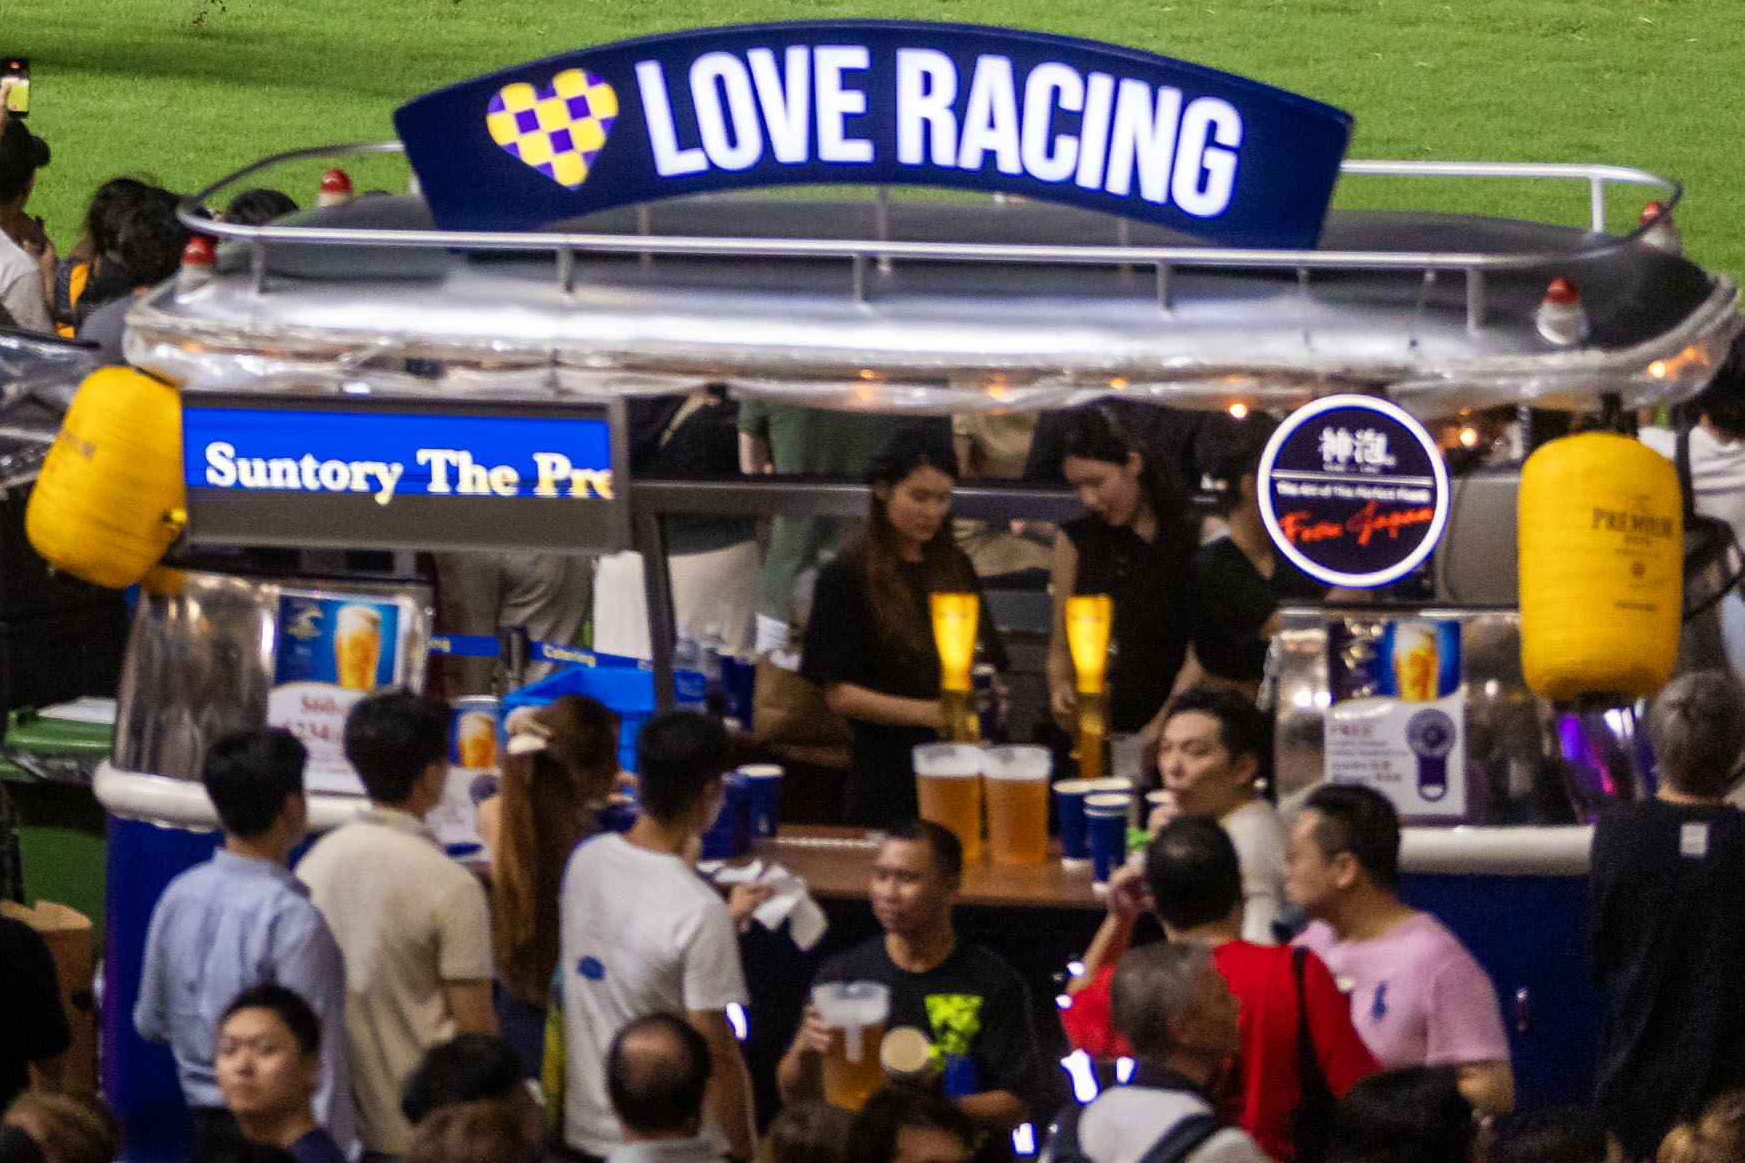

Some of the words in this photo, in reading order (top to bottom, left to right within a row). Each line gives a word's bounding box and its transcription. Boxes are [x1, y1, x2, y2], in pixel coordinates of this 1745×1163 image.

[635, 44, 876, 179] LOVE
[897, 47, 1245, 219] RACING
[204, 442, 404, 506] Suntory
[415, 448, 521, 496] The
